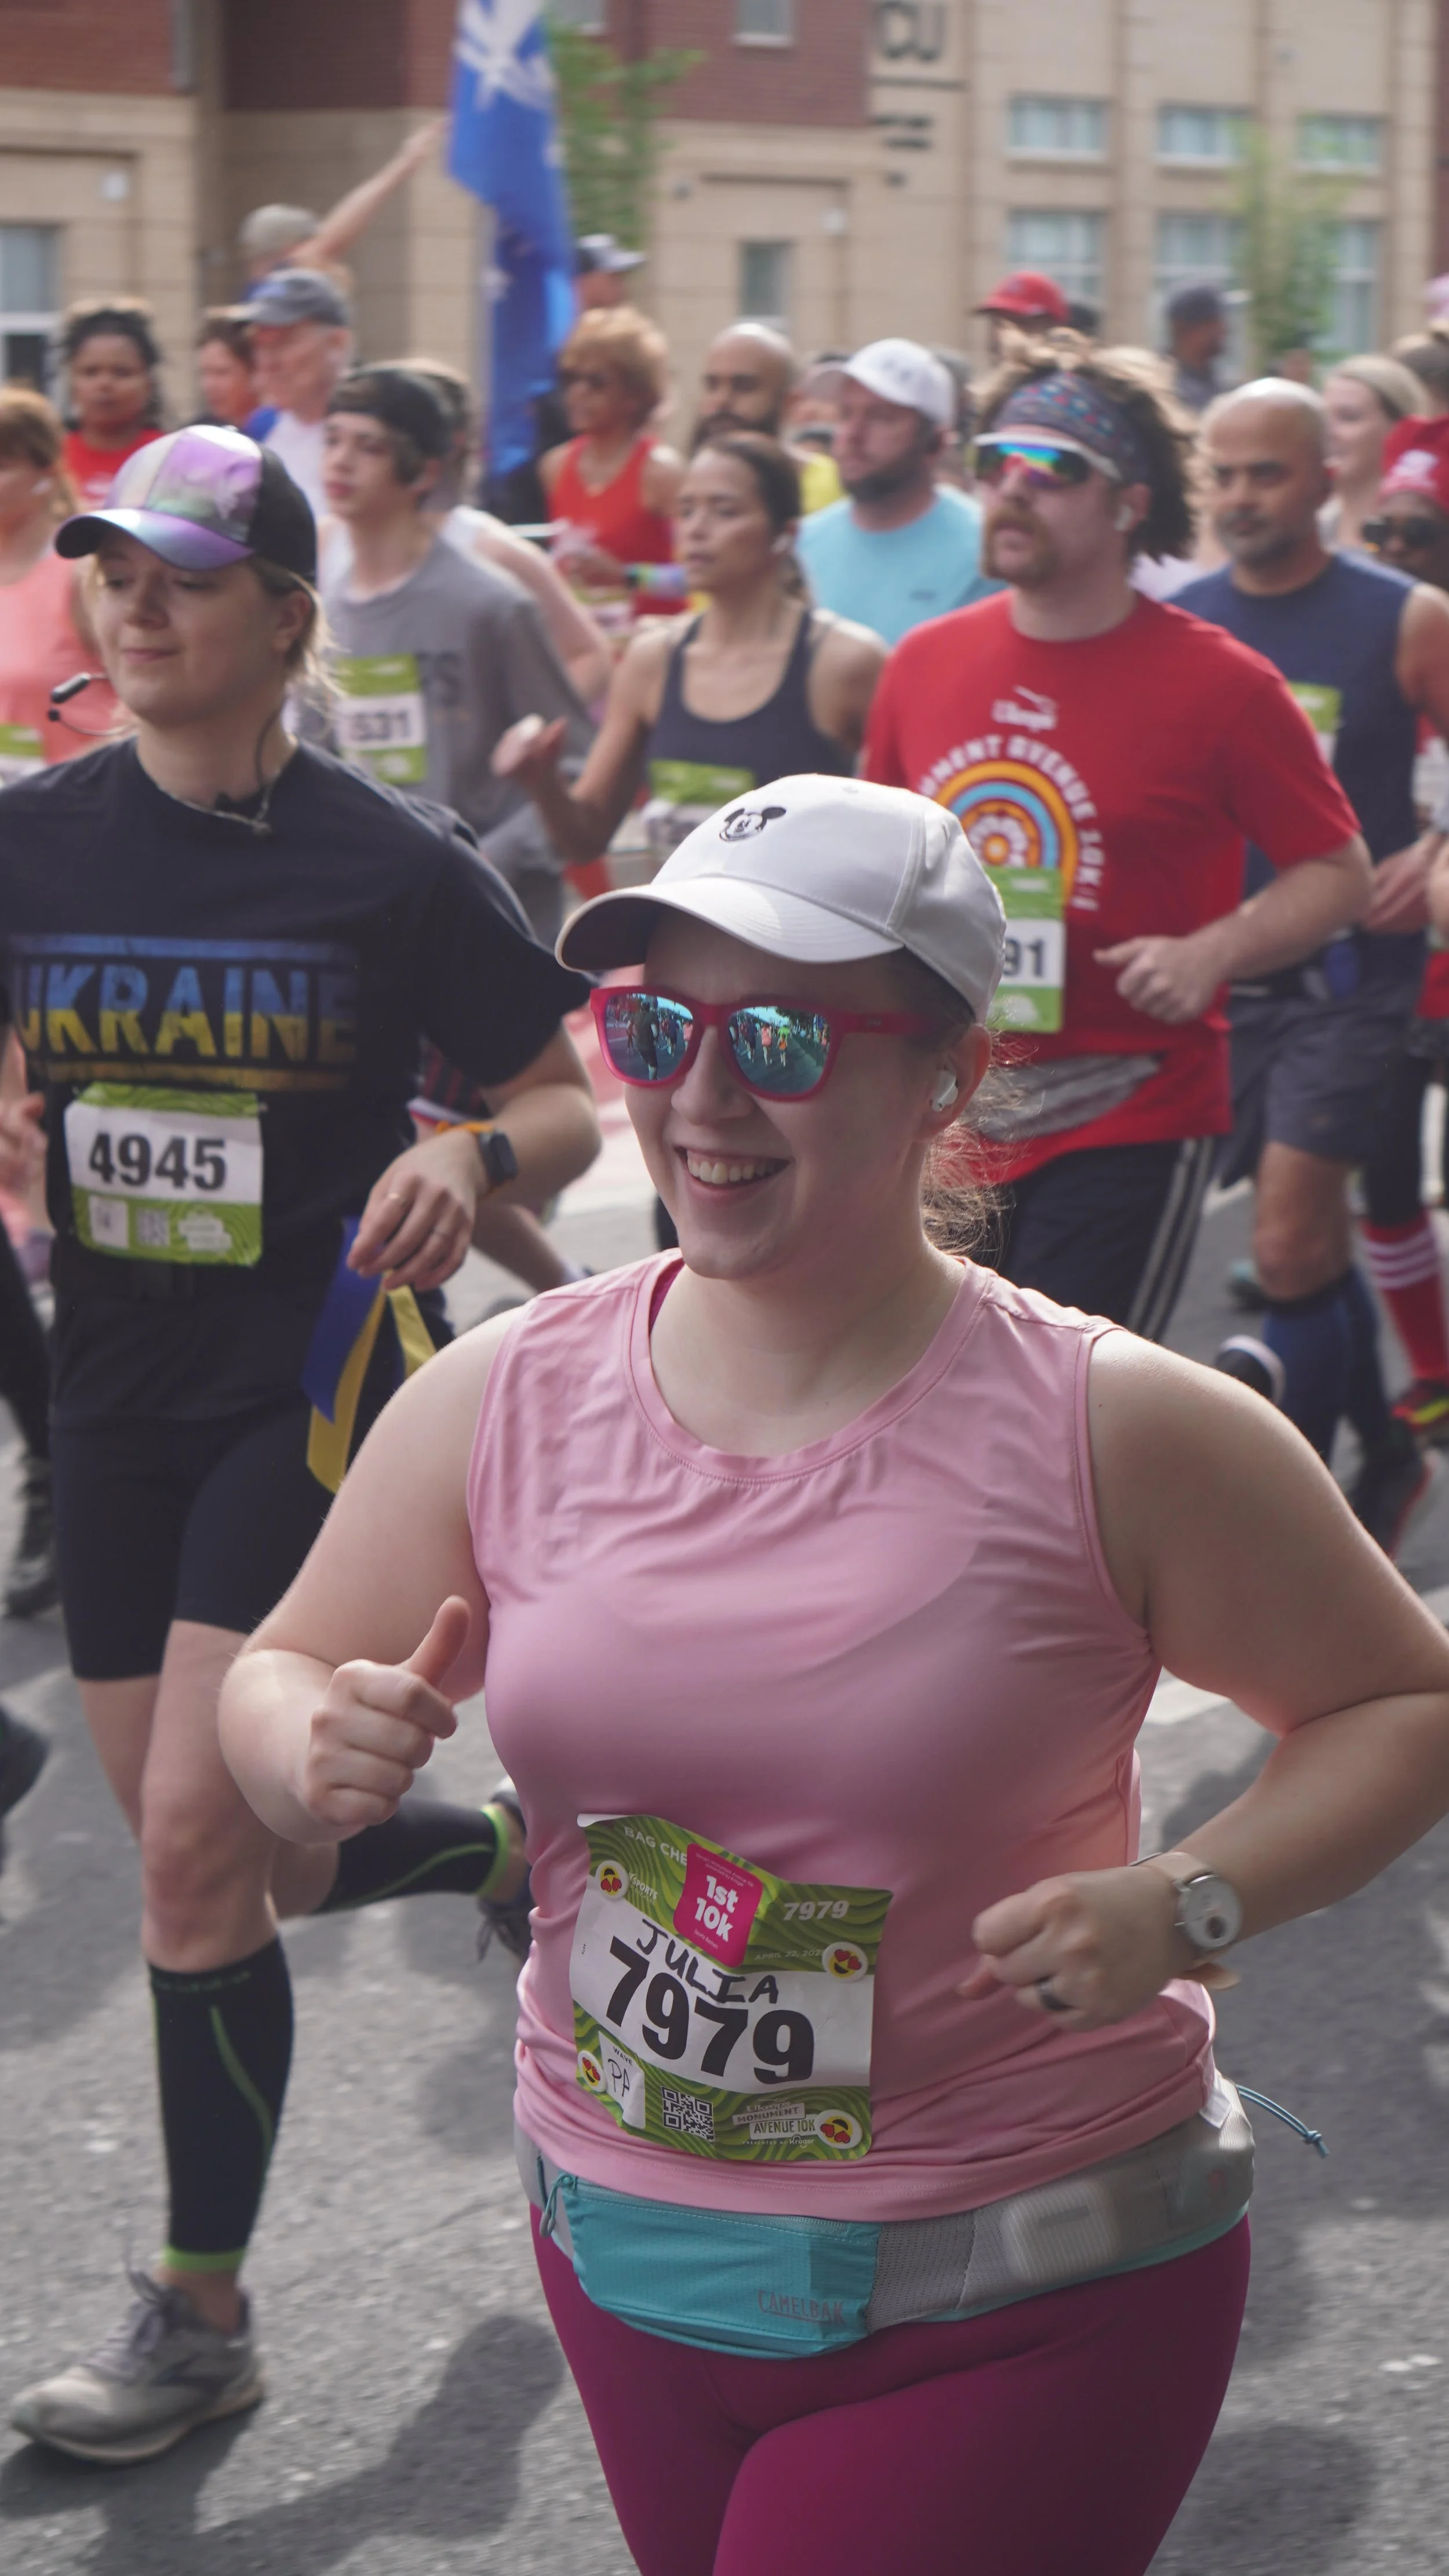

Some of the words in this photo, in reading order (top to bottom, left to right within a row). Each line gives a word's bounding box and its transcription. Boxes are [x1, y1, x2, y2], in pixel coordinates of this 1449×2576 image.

[1003, 937, 1046, 979] 91
[16, 962, 357, 1062] UKRAINE
[88, 1133, 227, 1191] 4945
[624, 1827, 656, 1848] BAG
[660, 1843, 687, 1866] CHE
[633, 1879, 658, 1900] SPORTS
[706, 1875, 738, 1913] 1st
[695, 1897, 733, 1942] 10k
[784, 1900, 849, 1921] 7979
[636, 1919, 778, 2004] JULIA
[606, 1935, 814, 2084] 7979
[613, 2046, 633, 2066] WAVE
[608, 2058, 630, 2097] PA
[737, 2106, 799, 2123] MONUMENT
[754, 2120, 795, 2134] AVENUE
[789, 2135, 814, 2148] Kroger
[758, 2289, 846, 2326] CAMELBAK
